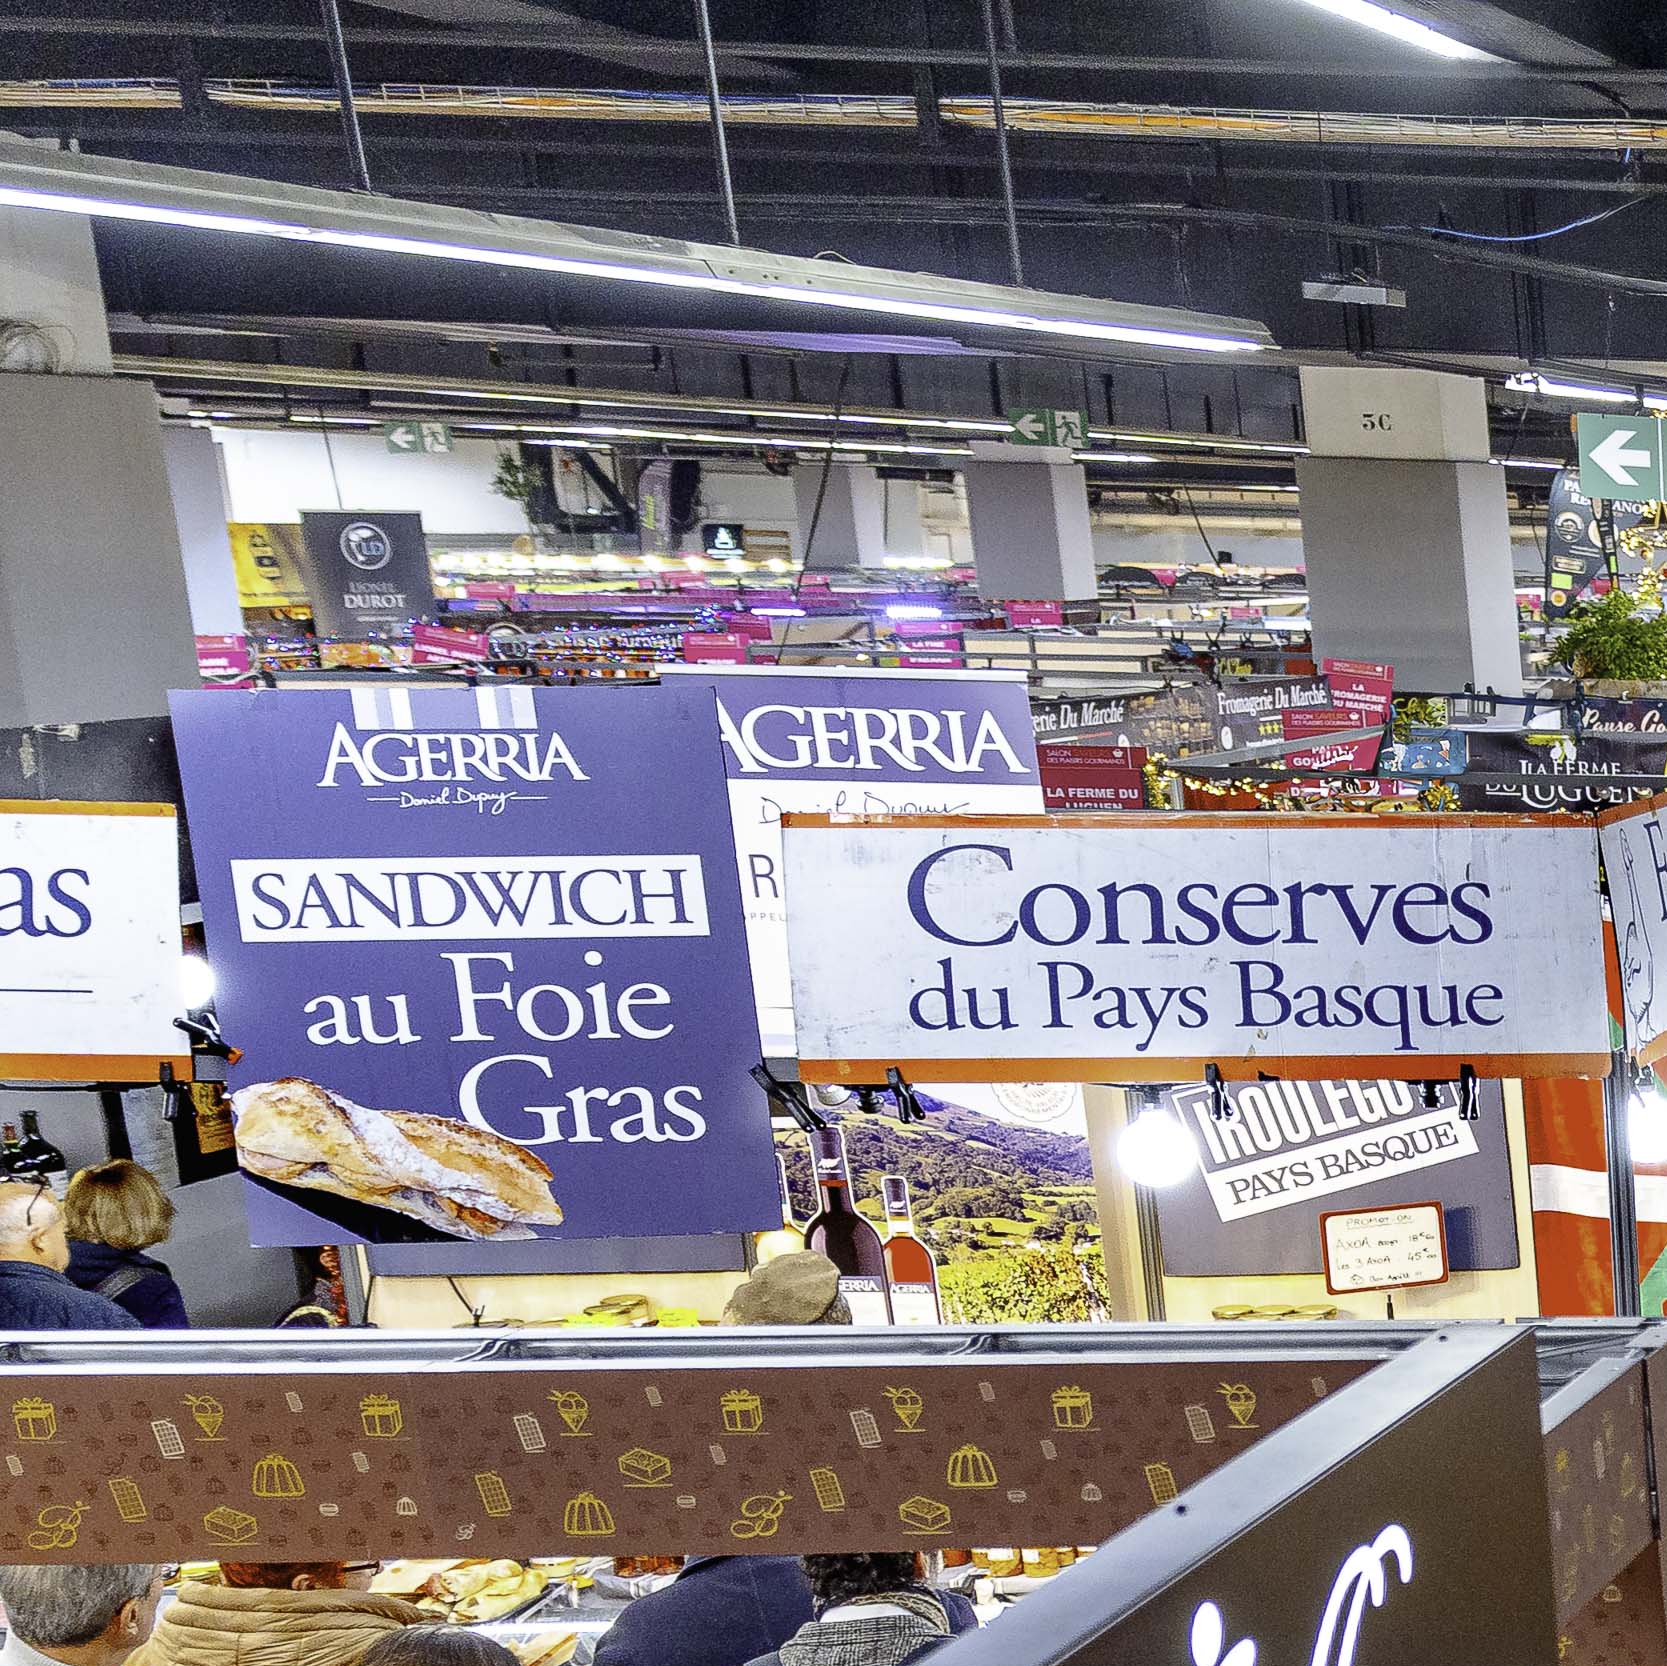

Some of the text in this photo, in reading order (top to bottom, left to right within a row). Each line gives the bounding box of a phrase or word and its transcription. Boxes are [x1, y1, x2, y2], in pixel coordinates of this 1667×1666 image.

[1362, 413, 1393, 433] 5C
[344, 595, 406, 609] DUROT
[1060, 700, 1125, 728] Du Marché
[1217, 683, 1328, 715] Fromagerie Du Marché
[717, 697, 1031, 774] AGERRIA
[1583, 709, 1637, 733] Pause
[316, 722, 590, 787] AGERRIA
[1553, 759, 1621, 775] FERME
[400, 787, 517, 814] Daniel Dupuy
[1046, 788, 1138, 799] LA FERME DU
[251, 868, 696, 930] SANDWICH
[906, 843, 1493, 947] Conserves
[304, 950, 676, 1045] au Foie
[909, 957, 1505, 1052] du Pays Basque
[457, 1053, 707, 1146] Gras
[1226, 1123, 1459, 1206] PAYS BASQUE
[890, 1283, 931, 1294] AGERRIA
